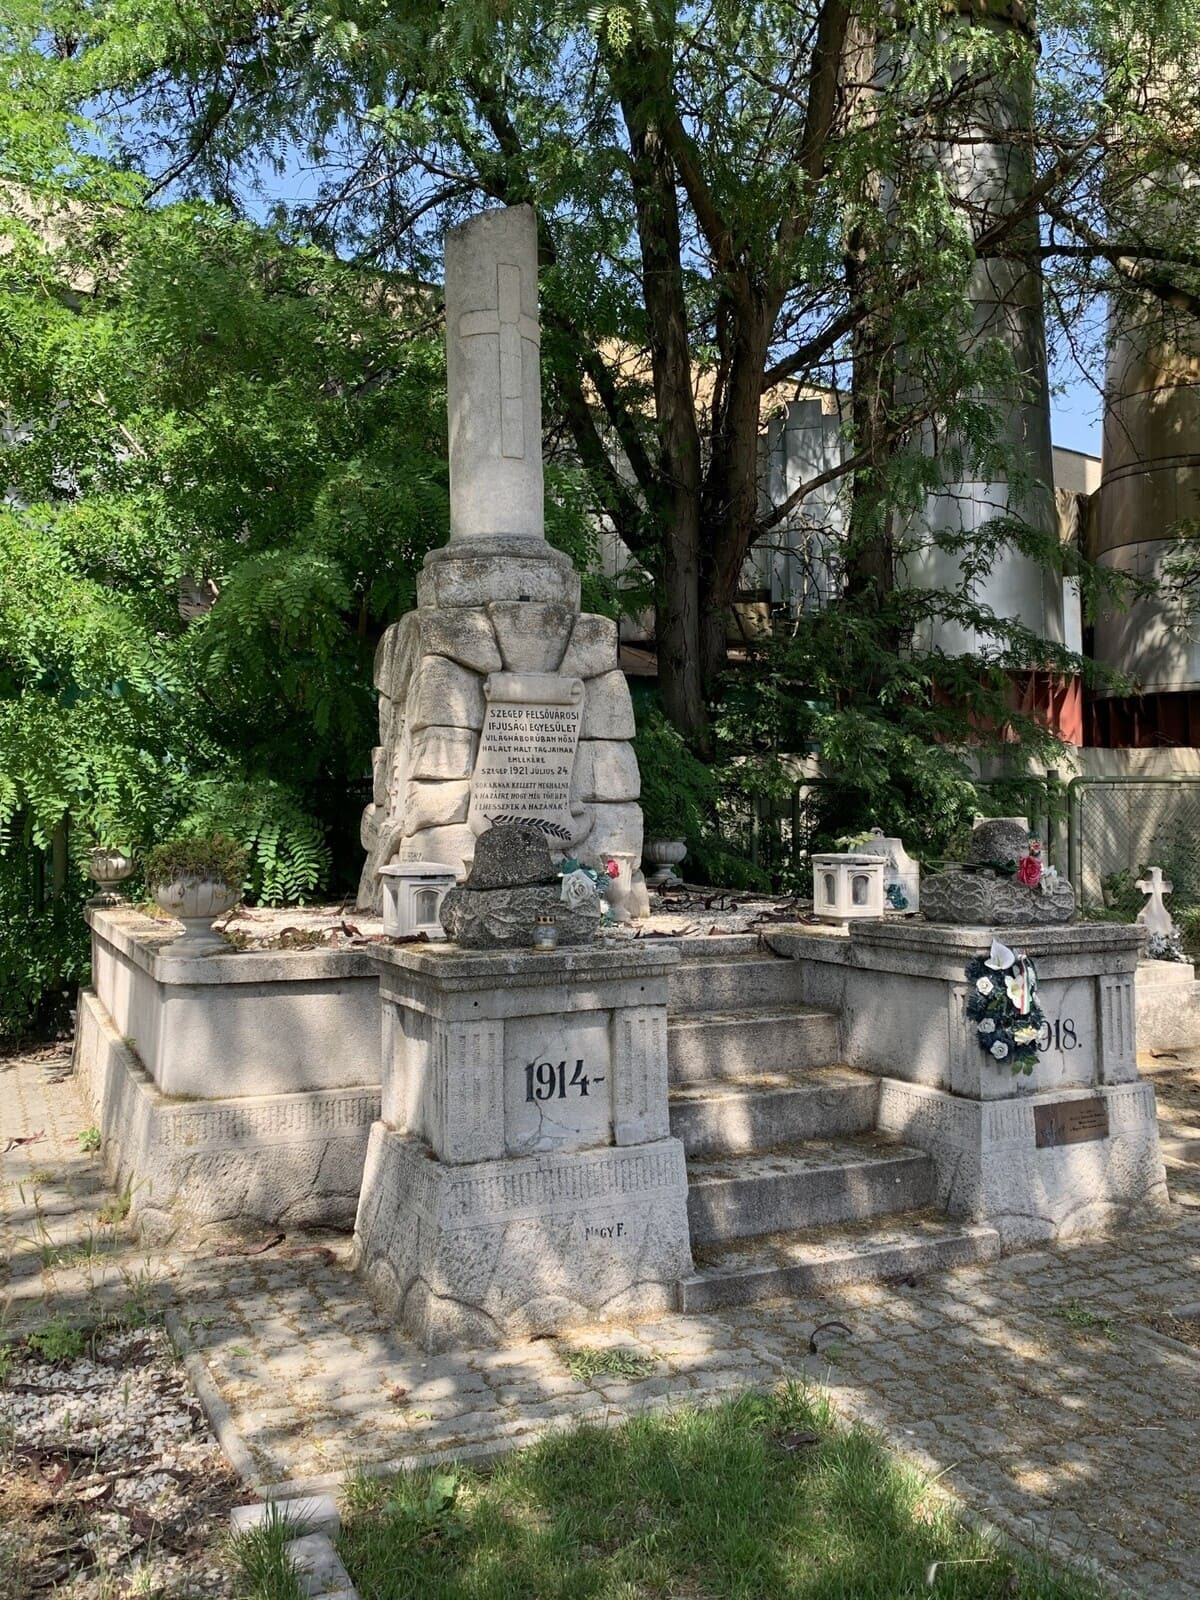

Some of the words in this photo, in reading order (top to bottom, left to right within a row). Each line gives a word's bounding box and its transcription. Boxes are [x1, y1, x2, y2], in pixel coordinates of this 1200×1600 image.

[490, 709, 523, 719] SZEGED
[513, 745, 533, 753] HALT
[534, 746, 574, 754] TAGJAINAK
[509, 766, 528, 775] 1921
[1037, 1018, 1083, 1053] 918.
